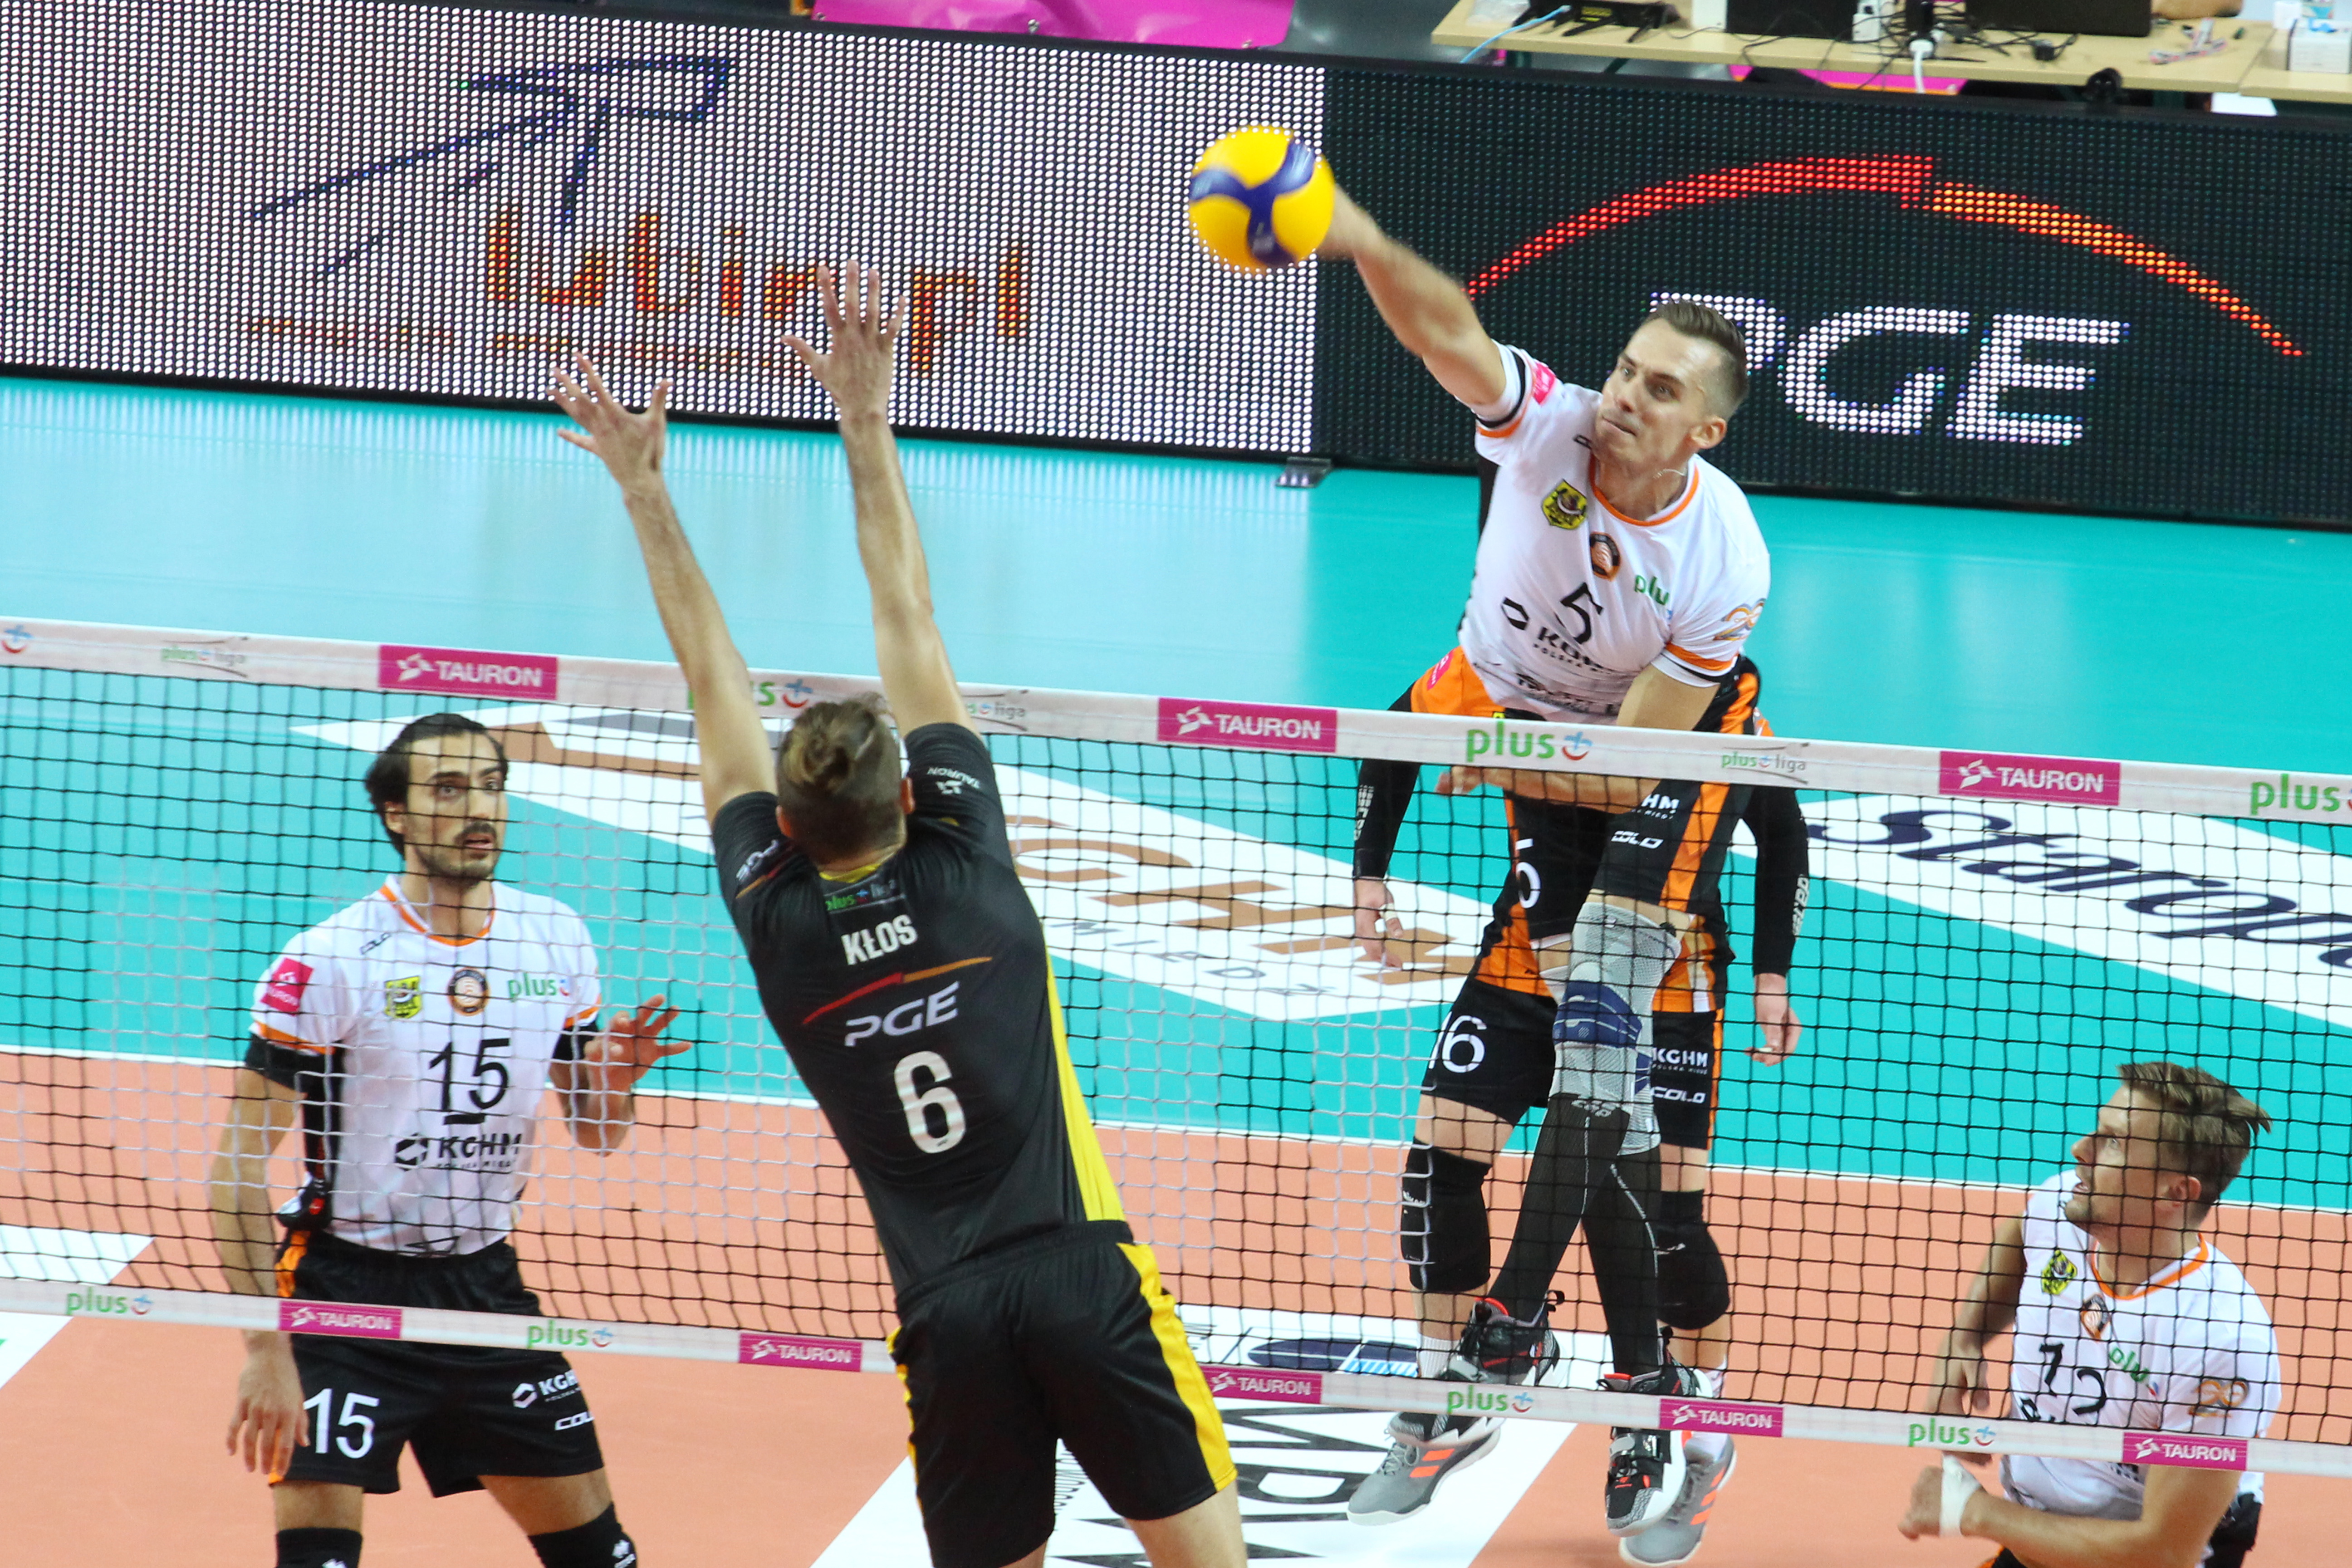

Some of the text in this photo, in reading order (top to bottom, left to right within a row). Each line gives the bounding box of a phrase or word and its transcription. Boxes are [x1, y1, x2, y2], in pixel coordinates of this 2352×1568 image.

[1560, 582, 1603, 645] 5
[435, 661, 541, 687] TAURON
[1215, 714, 1321, 740] TAURON
[1466, 721, 1555, 762] plus
[1721, 752, 1807, 773] plus liga
[1996, 766, 2103, 793] TAURON
[2250, 774, 2340, 815] plus
[841, 915, 918, 965] KŁOS
[507, 973, 556, 1002] plus
[844, 981, 960, 1047] PGE
[428, 1037, 510, 1112] 15
[894, 1051, 966, 1154] 6
[66, 1288, 128, 1316] plus
[318, 1311, 392, 1330] TAURON
[527, 1320, 588, 1349] plus
[777, 1345, 852, 1364] TAURON
[1238, 1377, 1312, 1396] TAURON
[1447, 1385, 1508, 1413] plus
[304, 1387, 379, 1459] 15
[1696, 1409, 1773, 1430] TAURON
[1908, 1417, 1970, 1448] plus
[2161, 1443, 2238, 1463] TAURON
